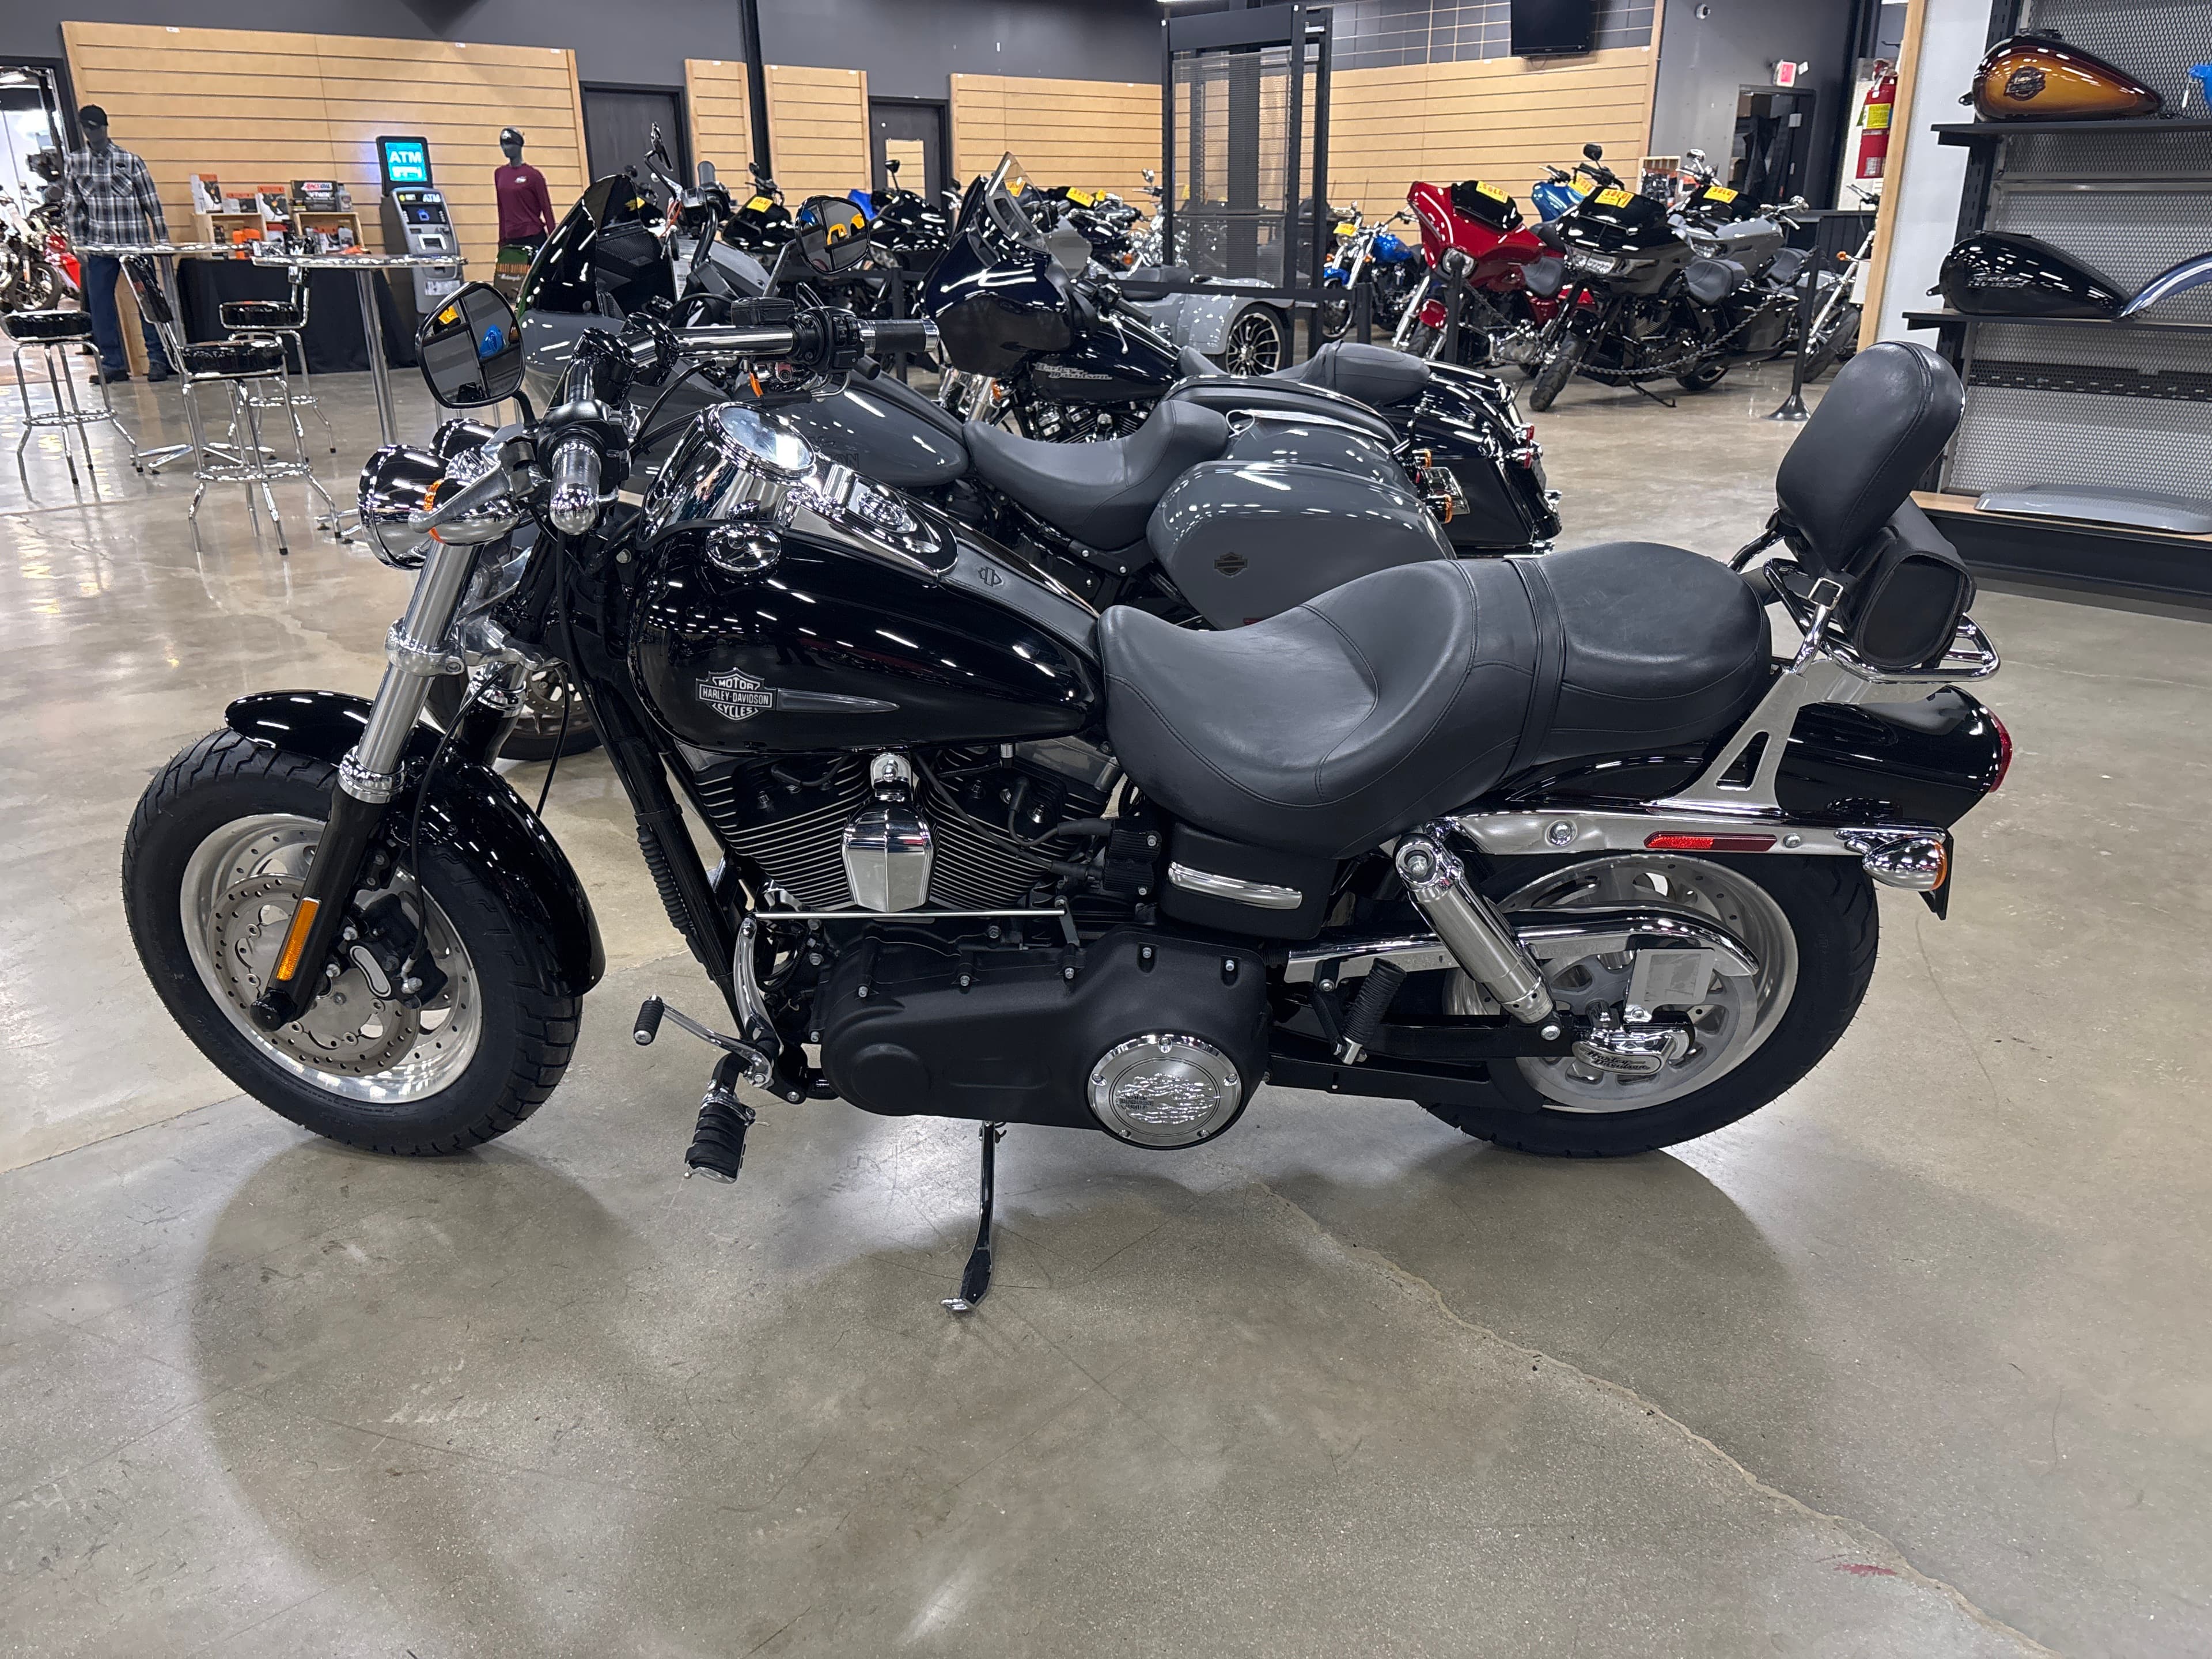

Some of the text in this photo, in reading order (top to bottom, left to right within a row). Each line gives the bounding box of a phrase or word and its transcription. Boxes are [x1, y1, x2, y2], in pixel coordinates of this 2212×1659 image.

[389, 151, 422, 164] ATM
[422, 194, 441, 202] ATM
[718, 677, 754, 691] MOTOR
[702, 687, 769, 705] HARLEY-DAVIDSON
[717, 703, 753, 718] CYCLES
[1583, 1050, 1635, 1065] Harley
[1592, 1058, 1650, 1070] Davidson
